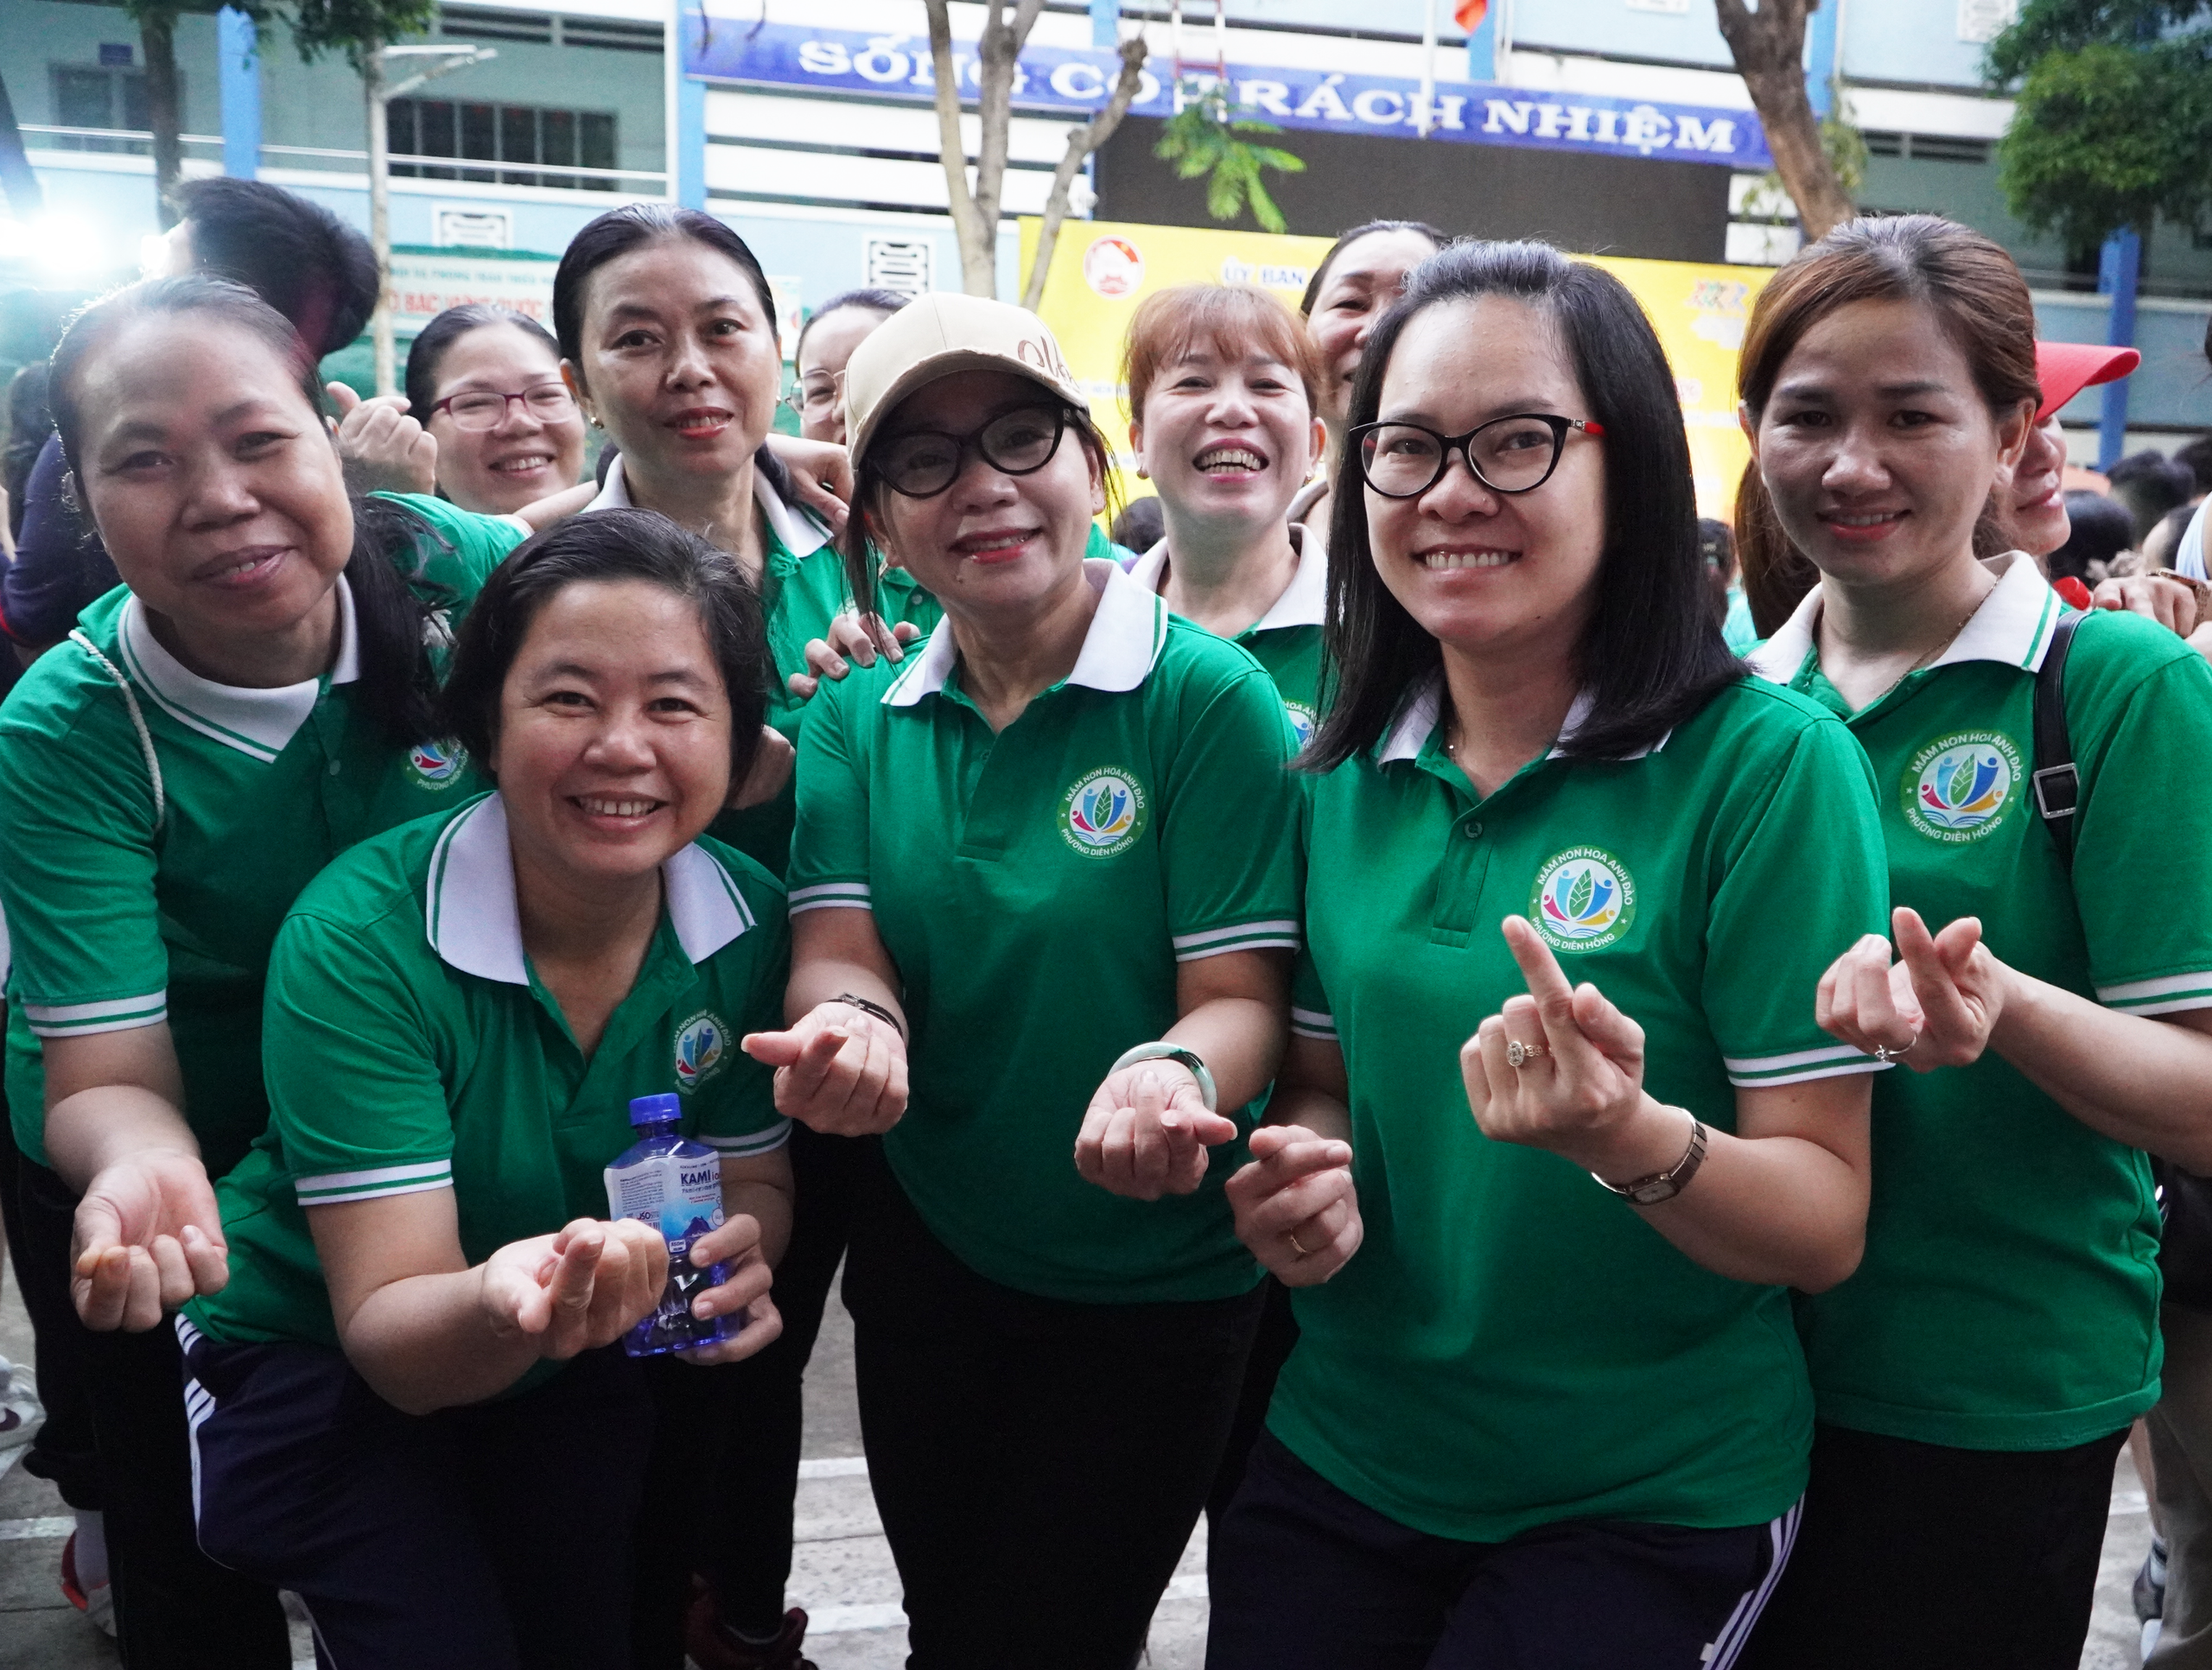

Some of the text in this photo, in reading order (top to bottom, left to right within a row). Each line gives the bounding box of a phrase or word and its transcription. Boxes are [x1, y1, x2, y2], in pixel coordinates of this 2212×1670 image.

[1481, 99, 1738, 155] NHIỆM
[1261, 266, 1305, 287] BAN
[1938, 733, 1967, 751] NON
[1992, 735, 2016, 757] ANH
[1083, 768, 1103, 784] NON
[1103, 767, 1122, 776] HOA
[1121, 772, 1138, 789] ANH
[1942, 831, 1971, 842] DIÊN
[1090, 847, 1110, 856] DIÊN
[1557, 848, 1581, 864] NON
[1583, 848, 1608, 863] HOA
[1607, 859, 1628, 881] ANH
[1561, 940, 1585, 950] DIÊN
[680, 1170, 711, 1184] KAMI
